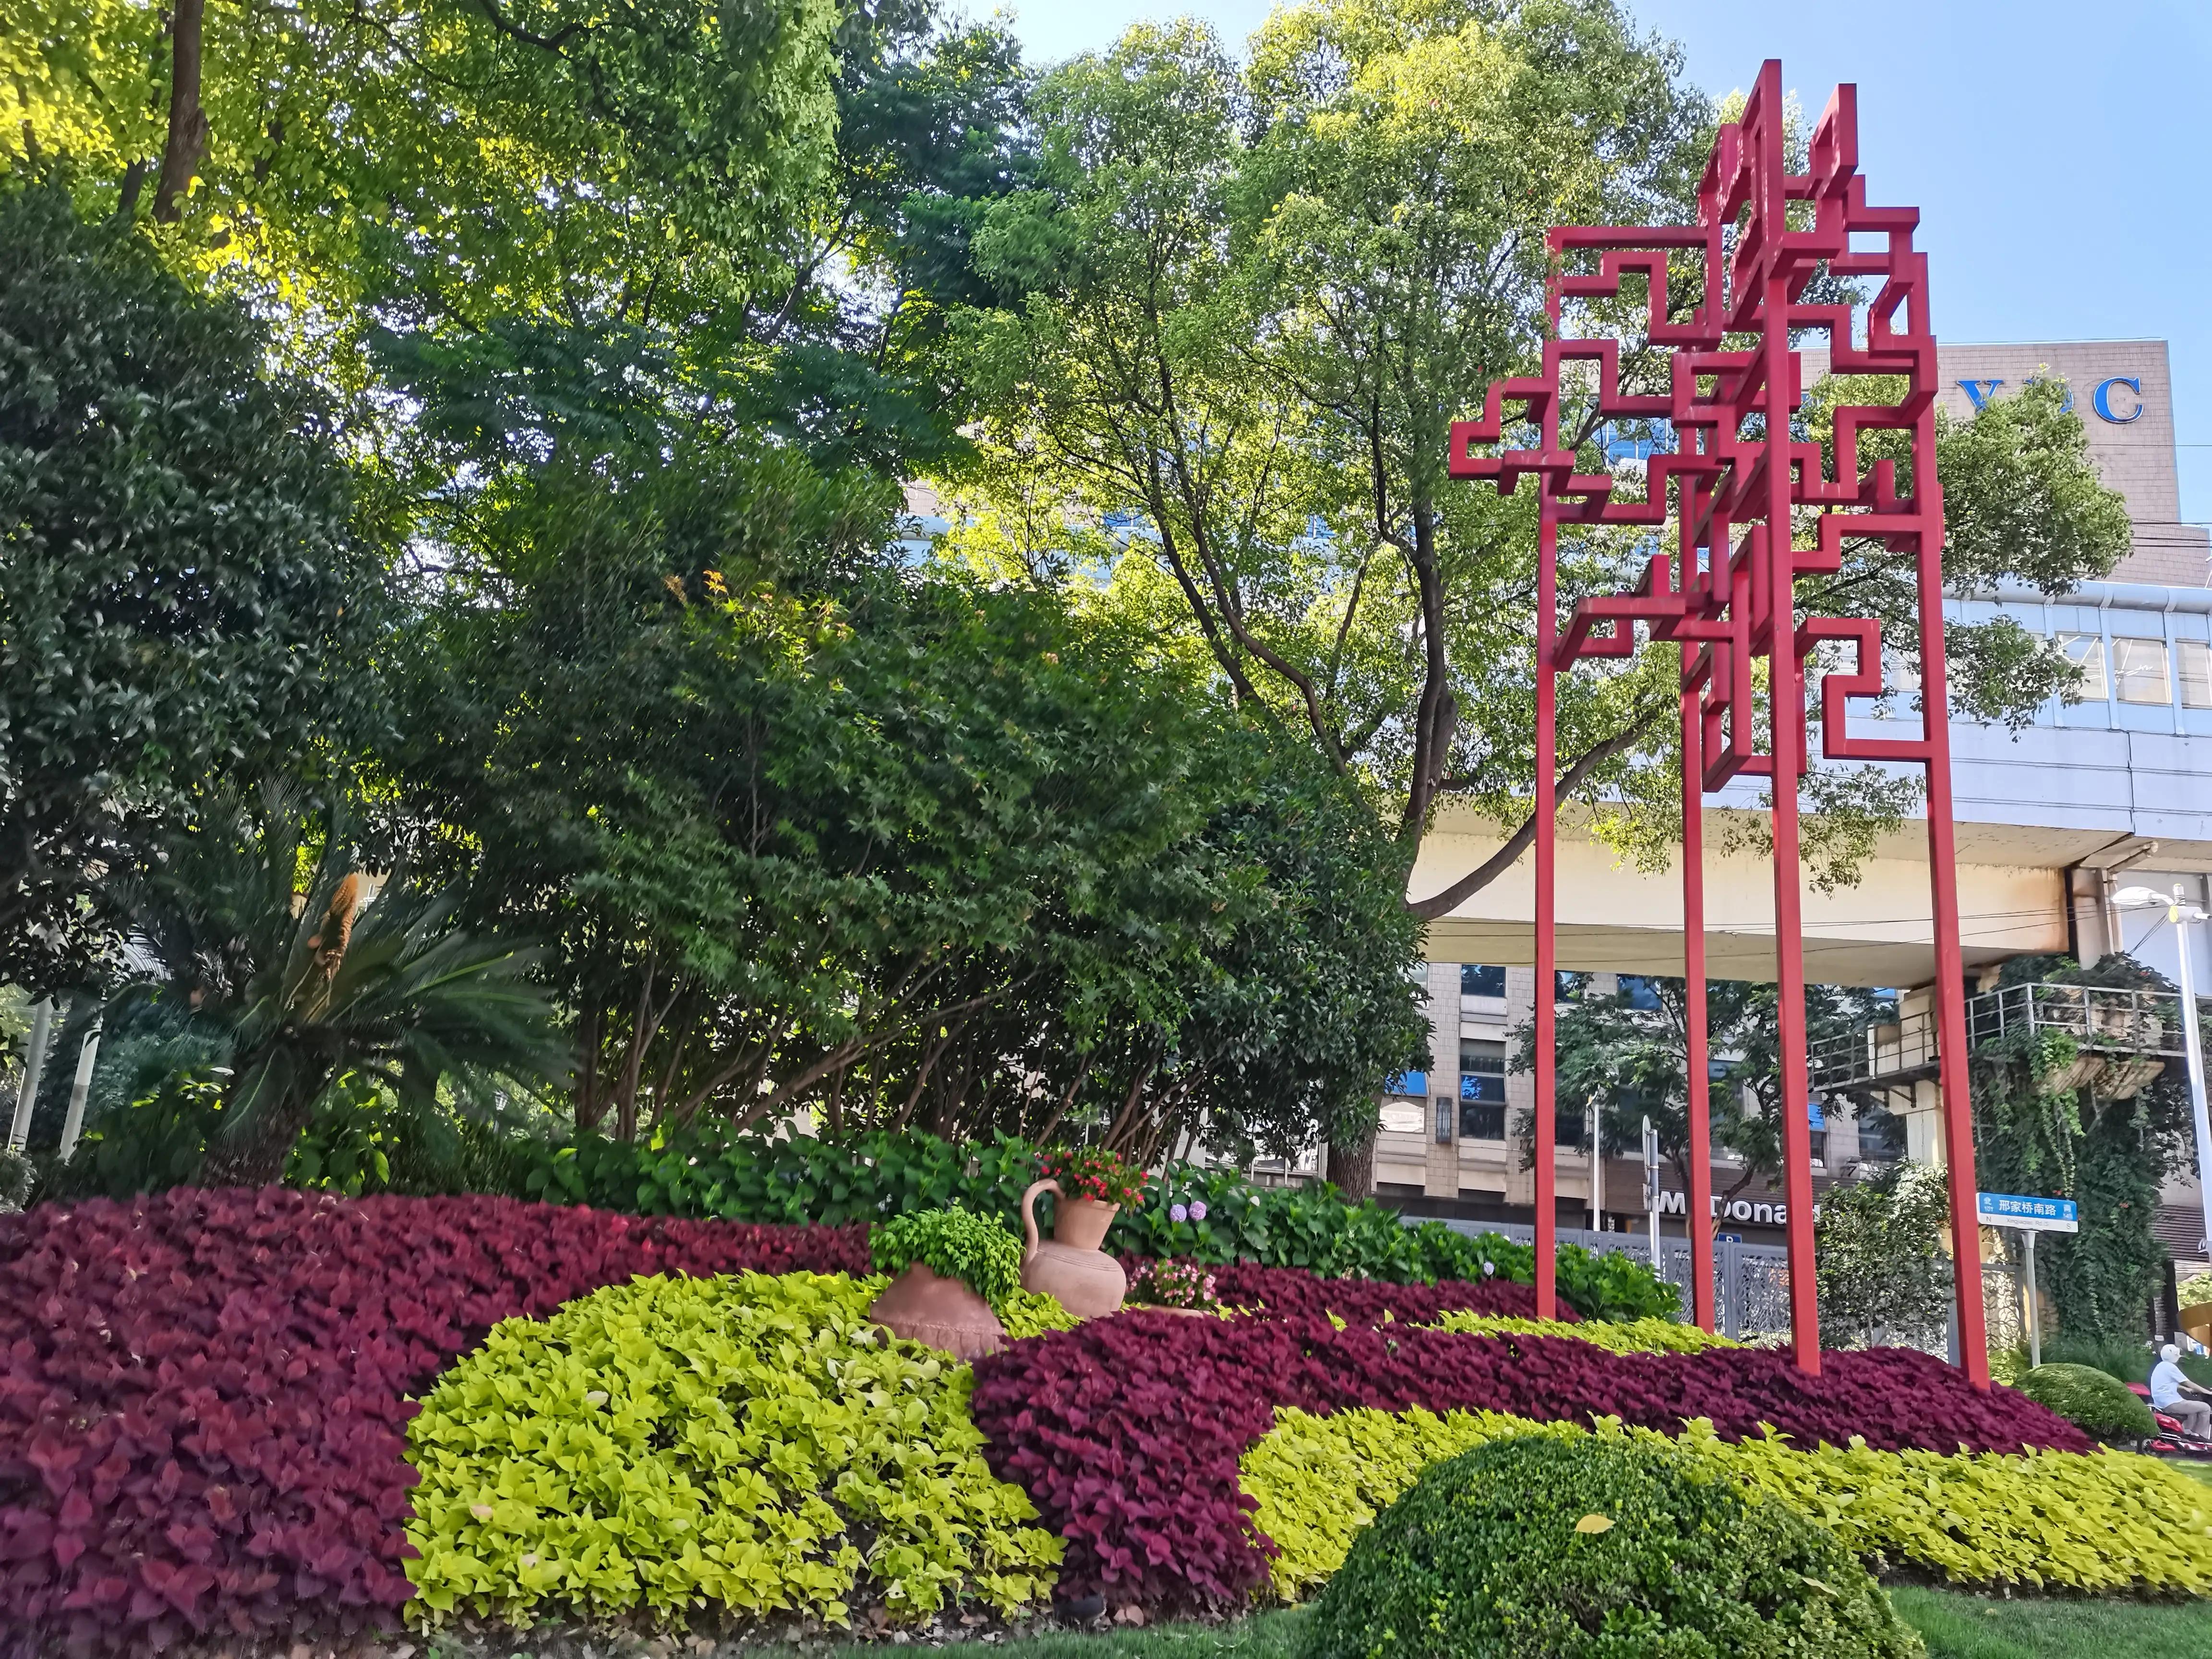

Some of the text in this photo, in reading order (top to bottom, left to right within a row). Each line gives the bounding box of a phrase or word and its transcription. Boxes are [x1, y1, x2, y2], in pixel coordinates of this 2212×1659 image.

[1957, 376, 2143, 424] YC
[1999, 1200, 2056, 1216] 邢家桥南路
